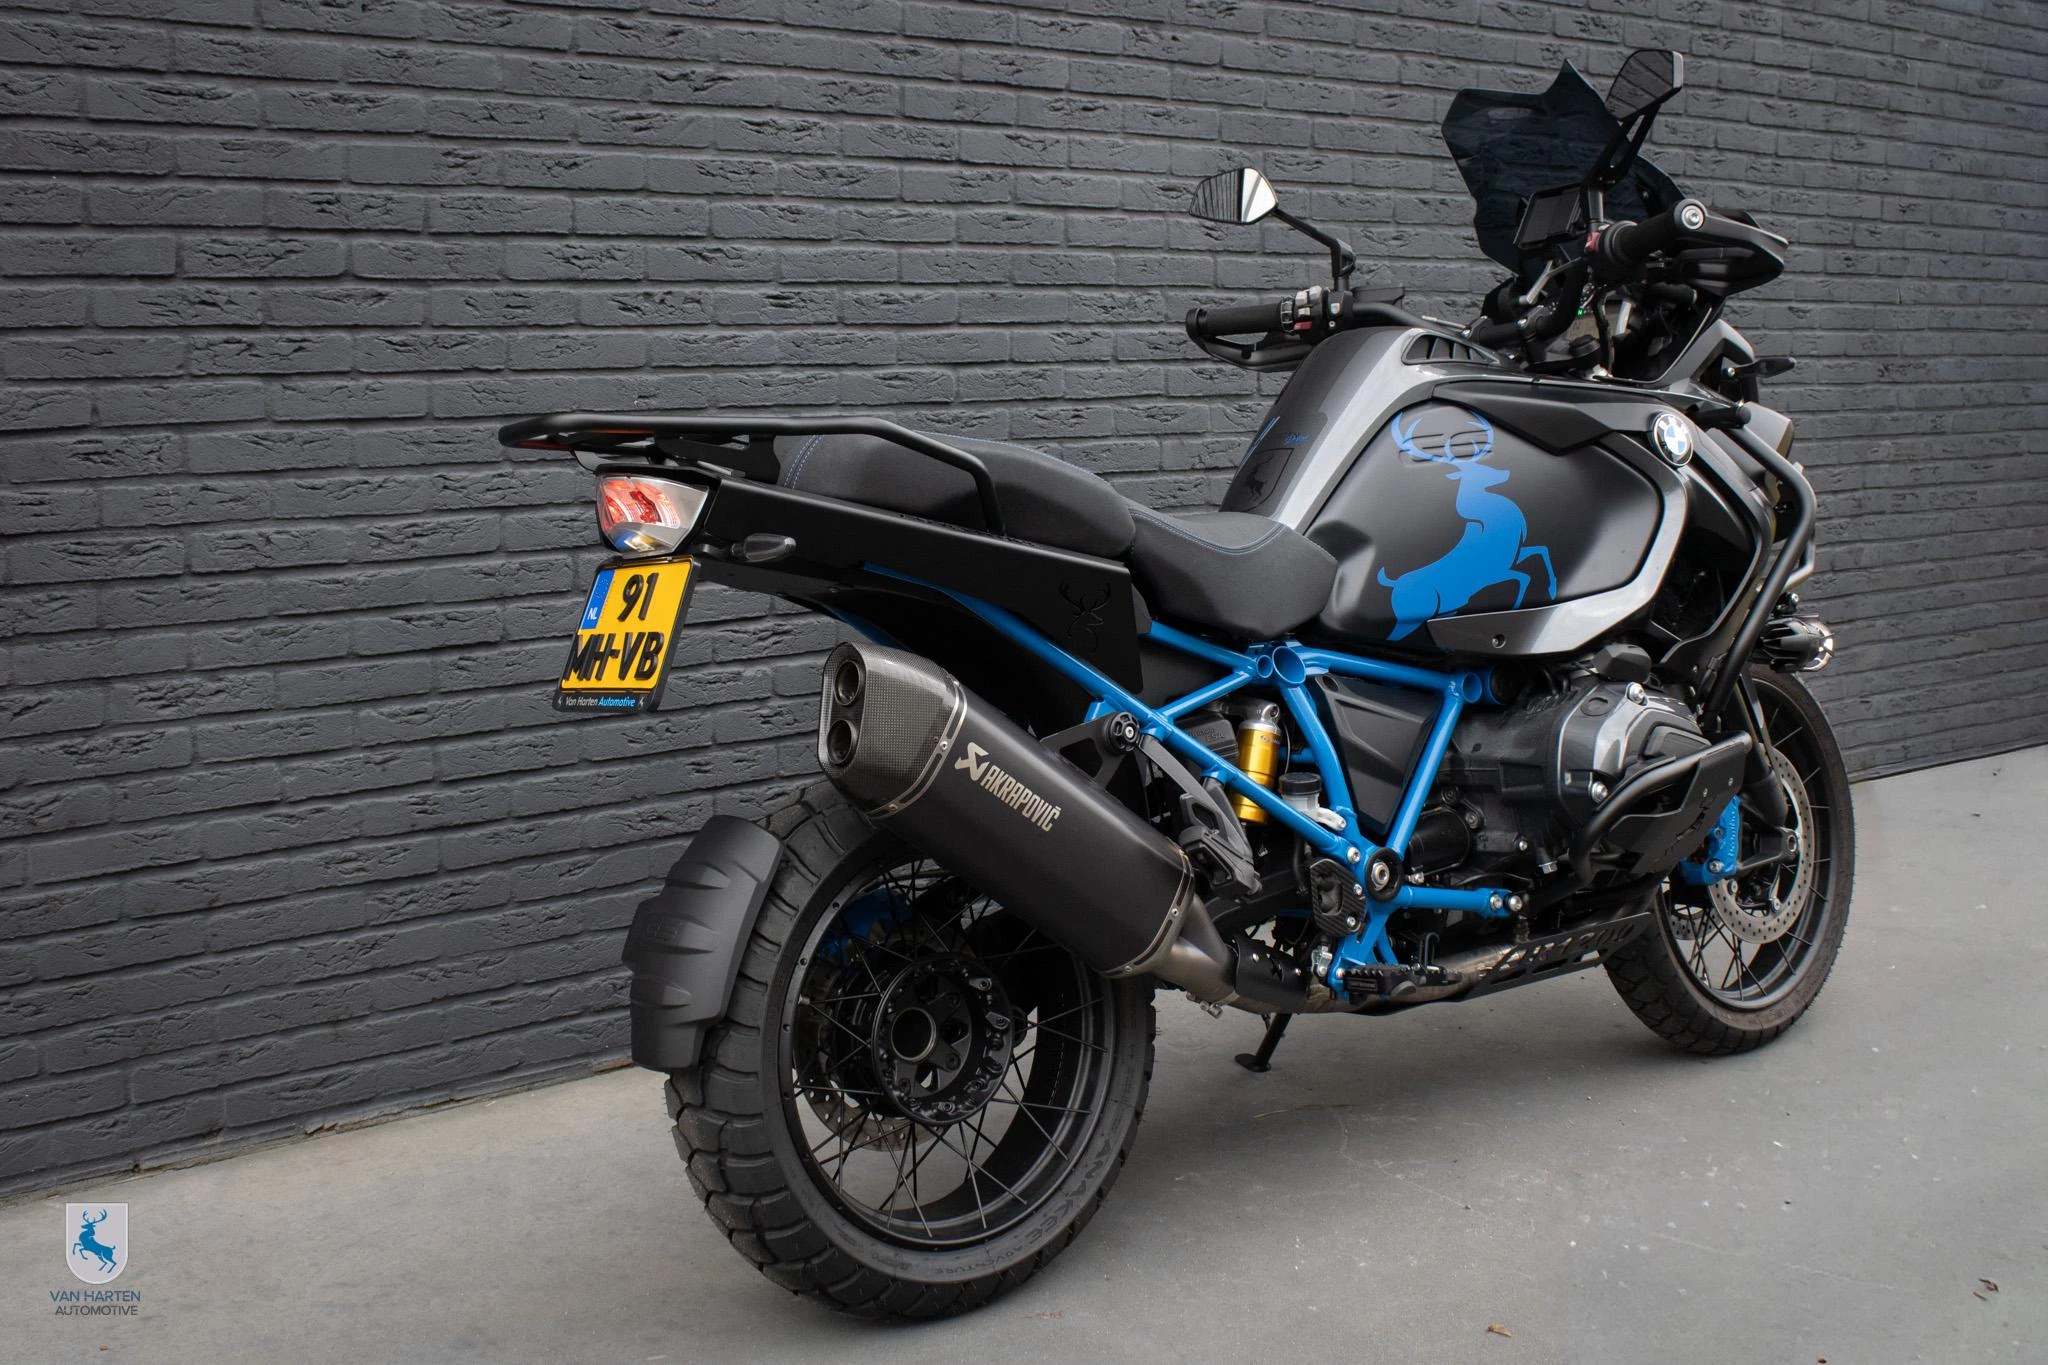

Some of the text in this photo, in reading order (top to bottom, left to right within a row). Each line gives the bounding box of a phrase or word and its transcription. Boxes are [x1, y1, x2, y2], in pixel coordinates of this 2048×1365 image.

[617, 572, 660, 622] 91
[587, 607, 598, 620] NL
[563, 631, 665, 681] MH-VB
[565, 697, 636, 707] Van Harten Automotive
